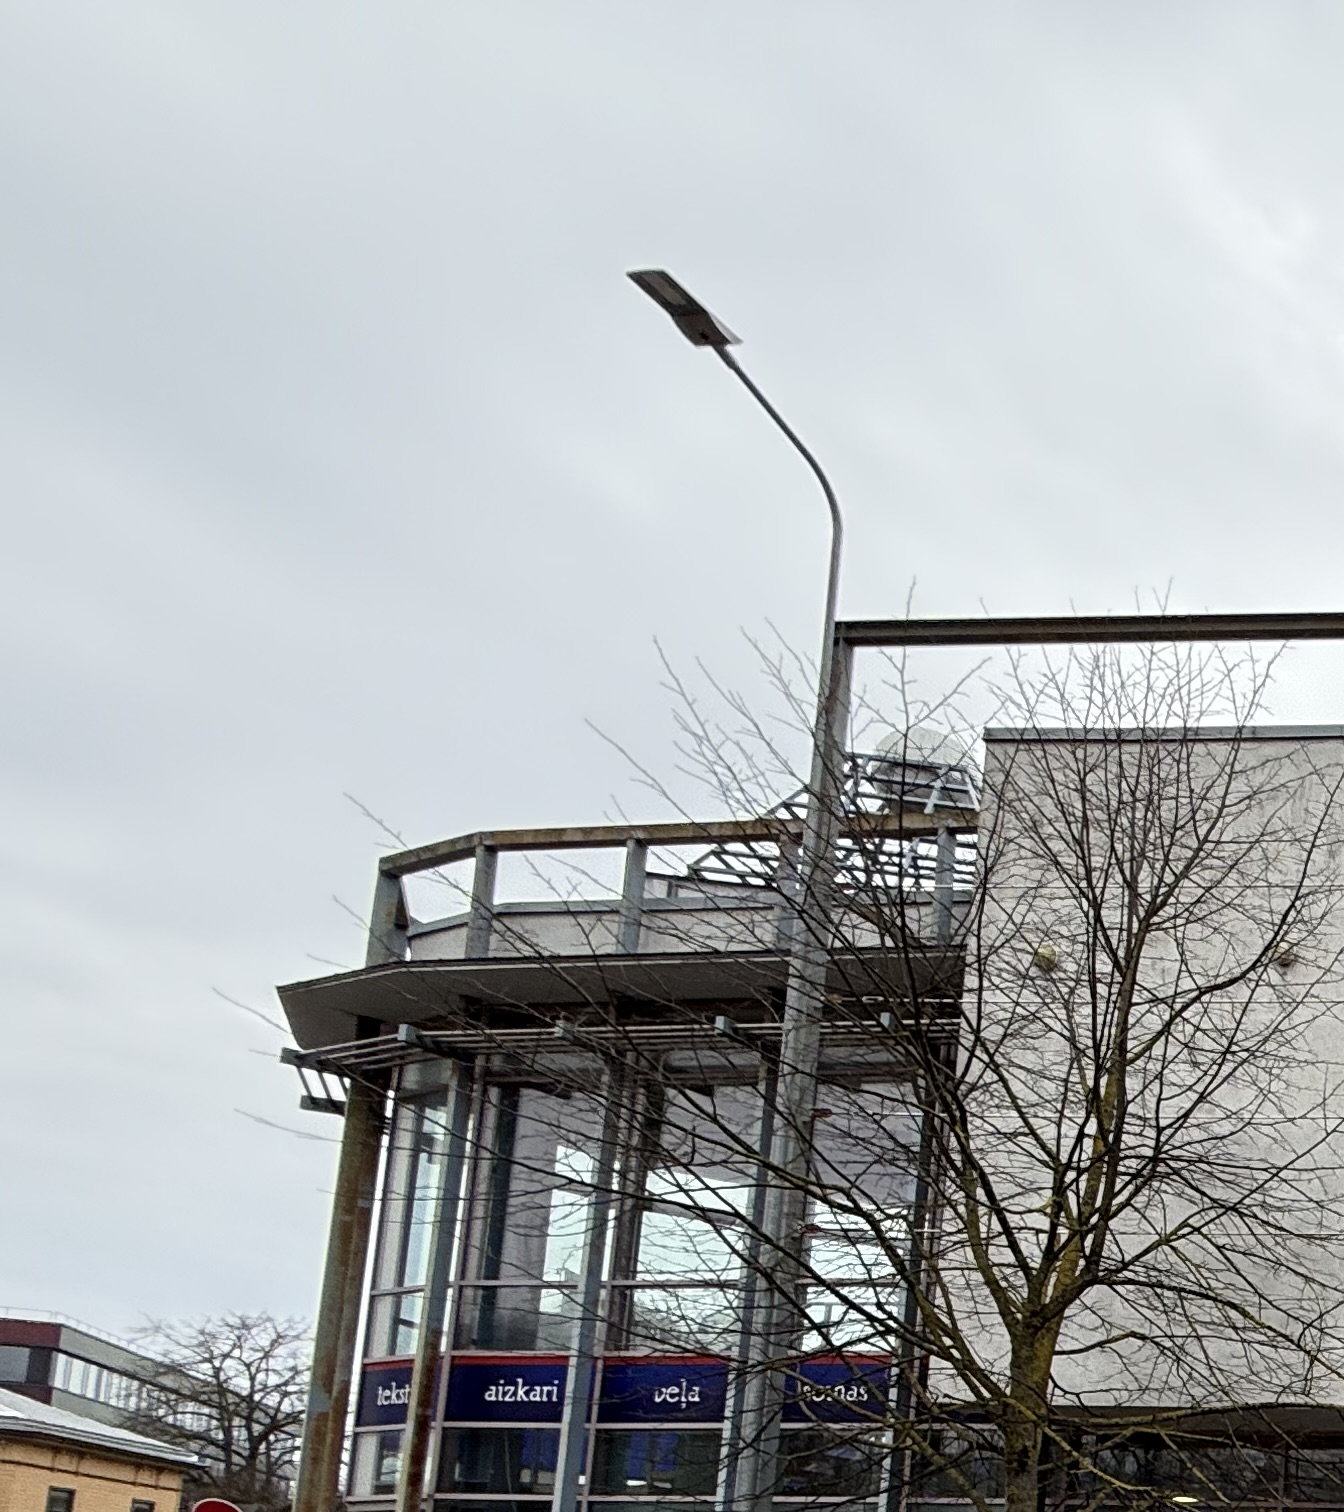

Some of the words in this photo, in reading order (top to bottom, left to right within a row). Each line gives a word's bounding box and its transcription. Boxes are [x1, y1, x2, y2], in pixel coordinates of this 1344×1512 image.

[377, 1381, 411, 1406] tekst
[484, 1378, 559, 1402] aizkari
[653, 1378, 701, 1409] veļa
